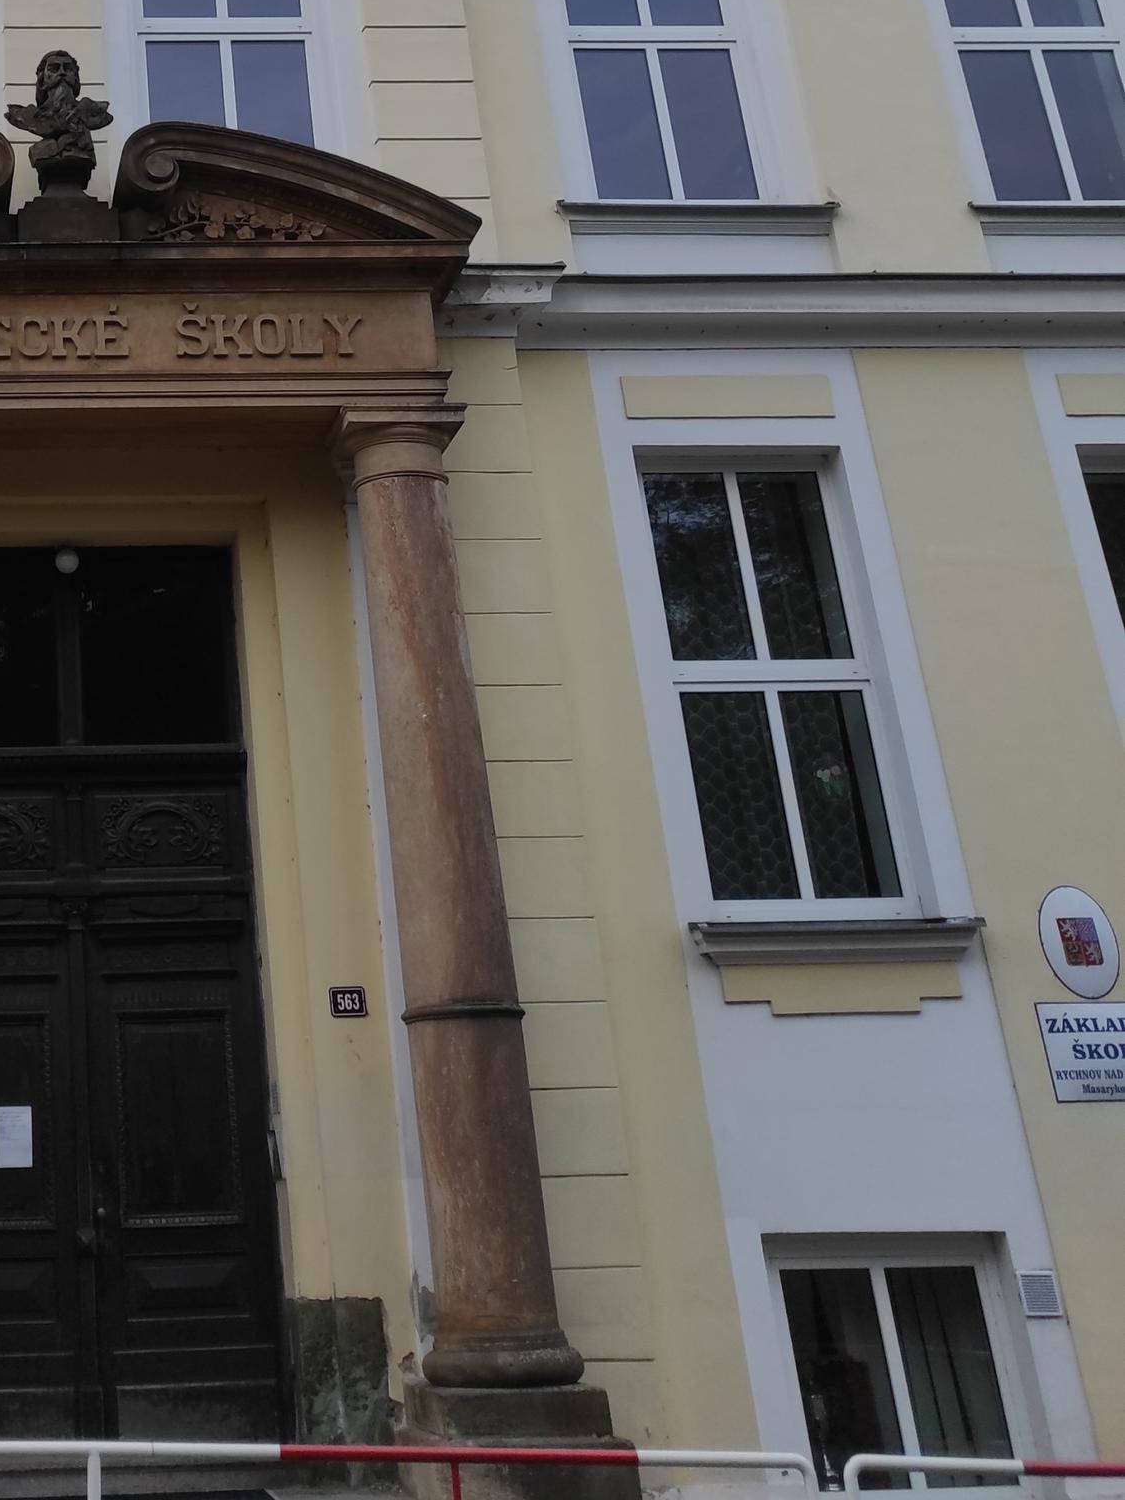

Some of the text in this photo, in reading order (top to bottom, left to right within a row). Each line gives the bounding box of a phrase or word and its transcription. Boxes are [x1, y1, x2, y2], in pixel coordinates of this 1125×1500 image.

[176, 302, 362, 357] ŠKOLY
[337, 993, 360, 1010] 563
[1055, 1069, 1124, 1080] RYCHNOV NAD
